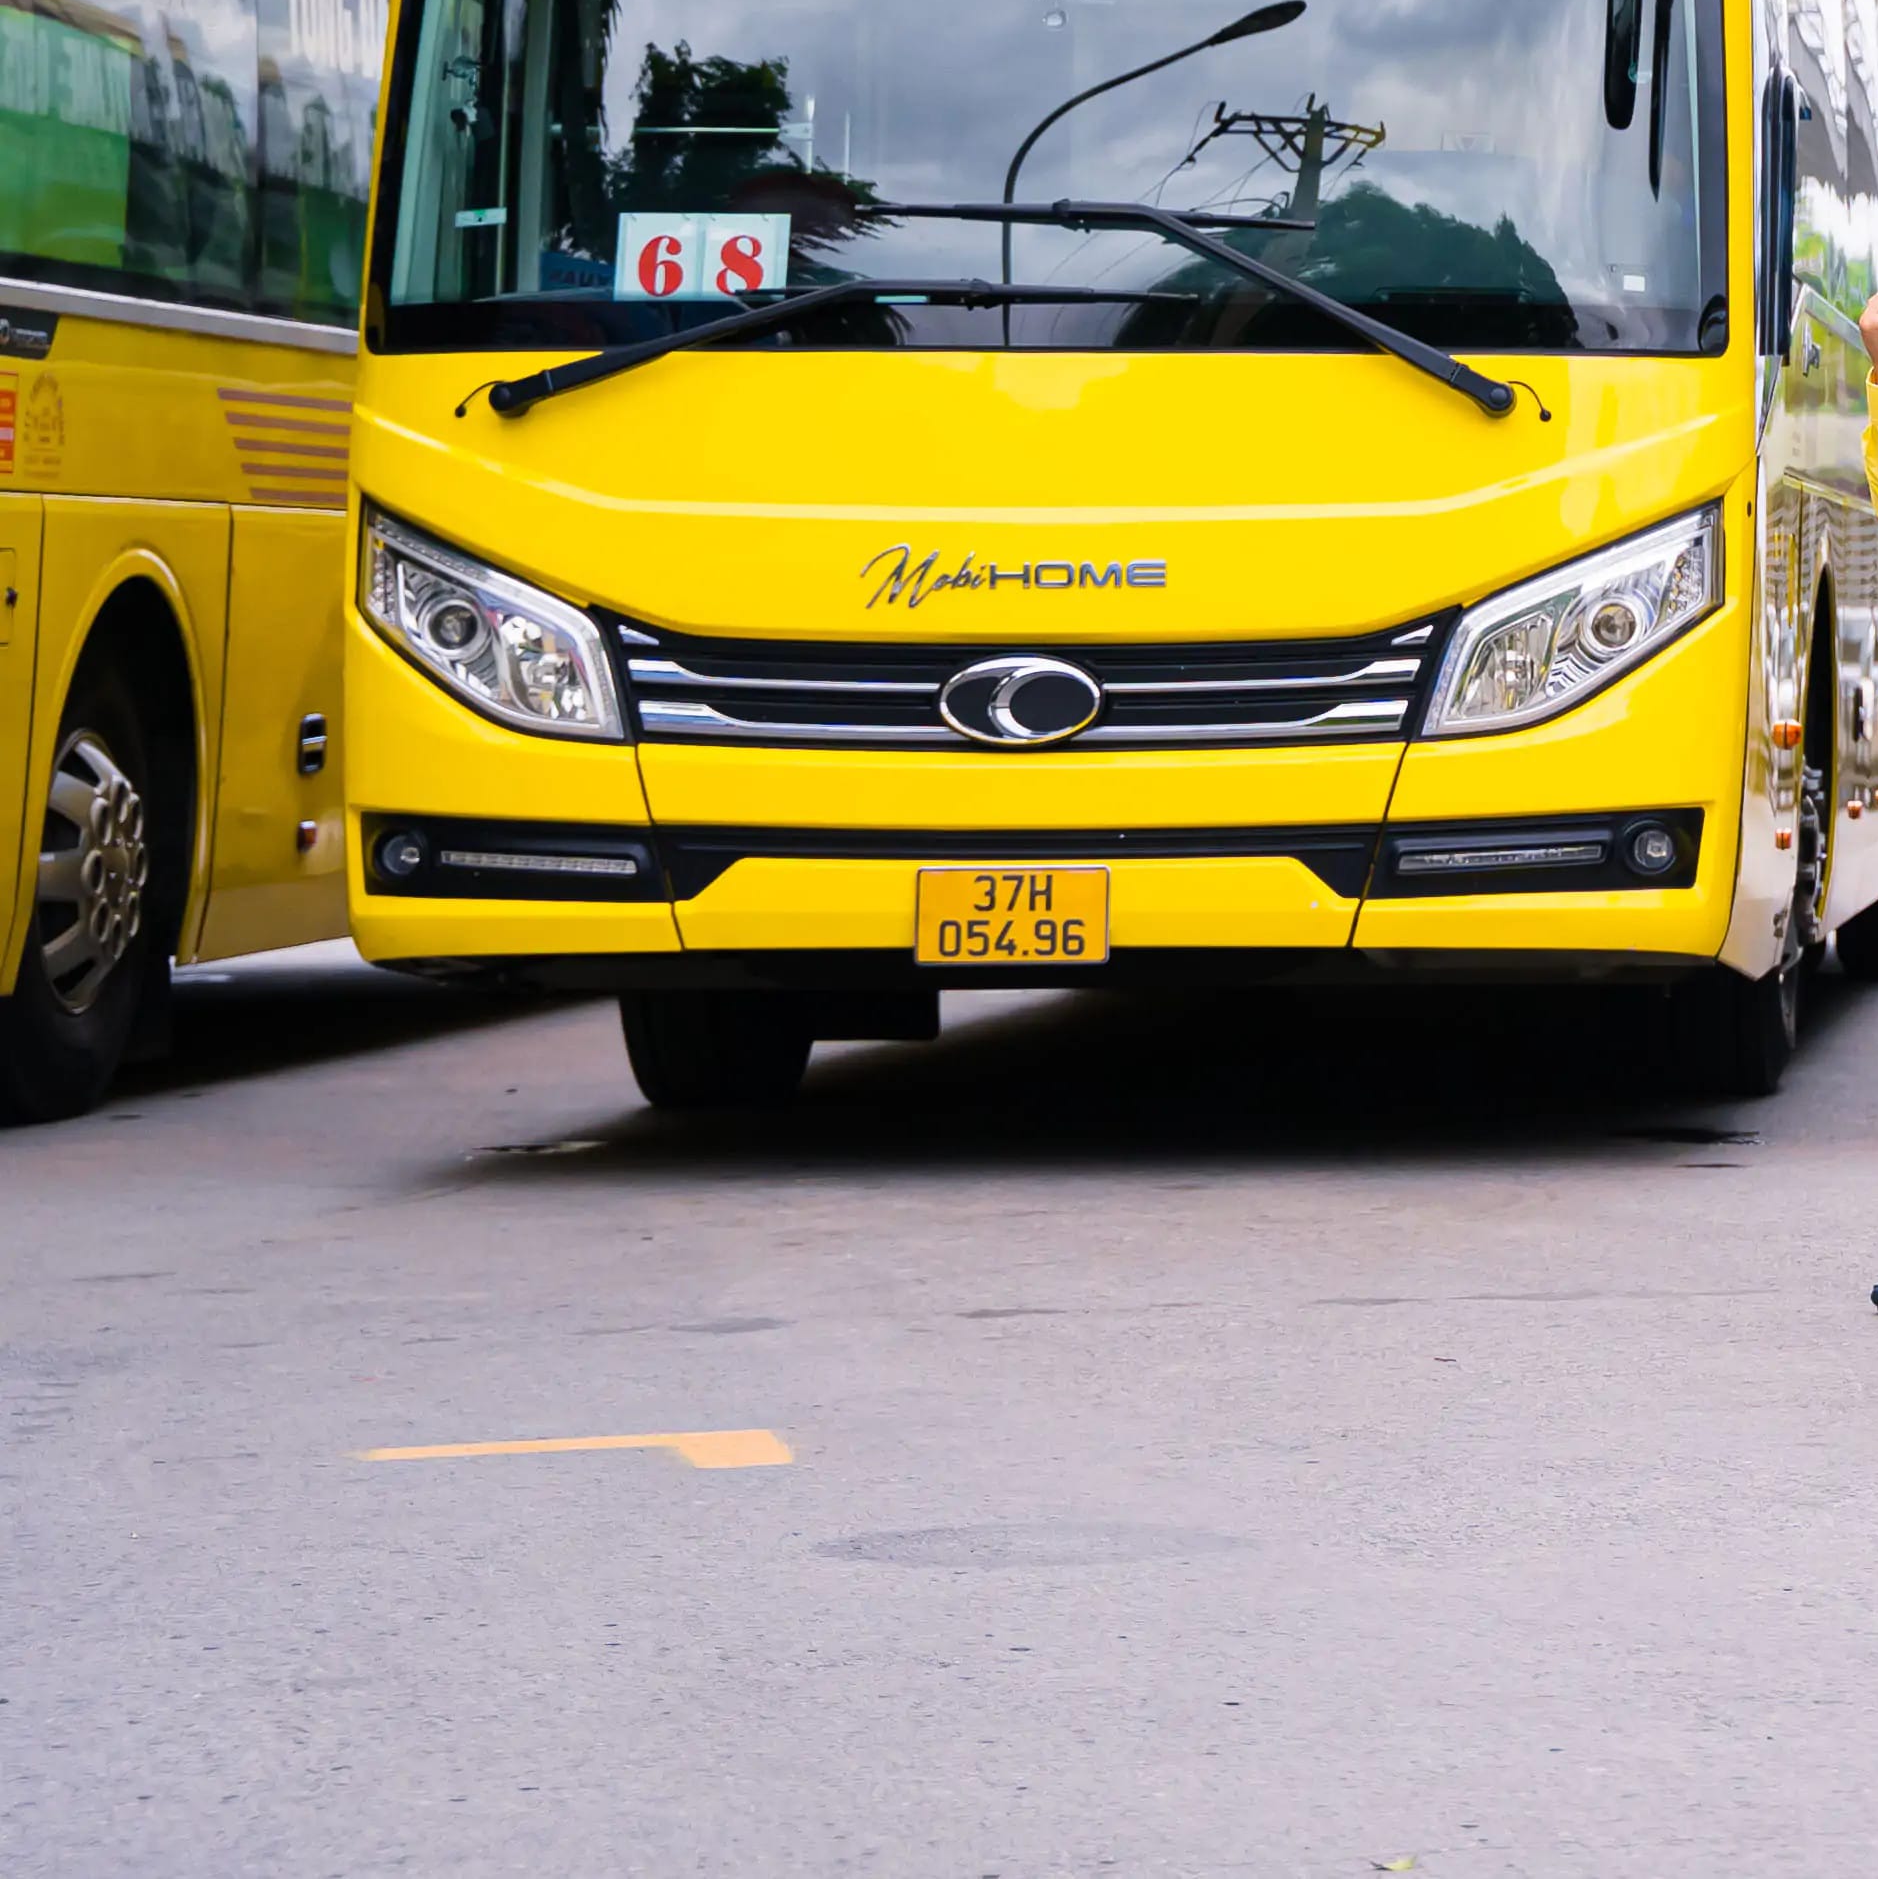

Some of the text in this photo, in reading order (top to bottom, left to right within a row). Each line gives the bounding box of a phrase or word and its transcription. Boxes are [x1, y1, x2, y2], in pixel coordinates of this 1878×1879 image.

[637, 234, 763, 297] 68
[972, 875, 1053, 914] 37H
[938, 920, 1086, 958] 054.96
